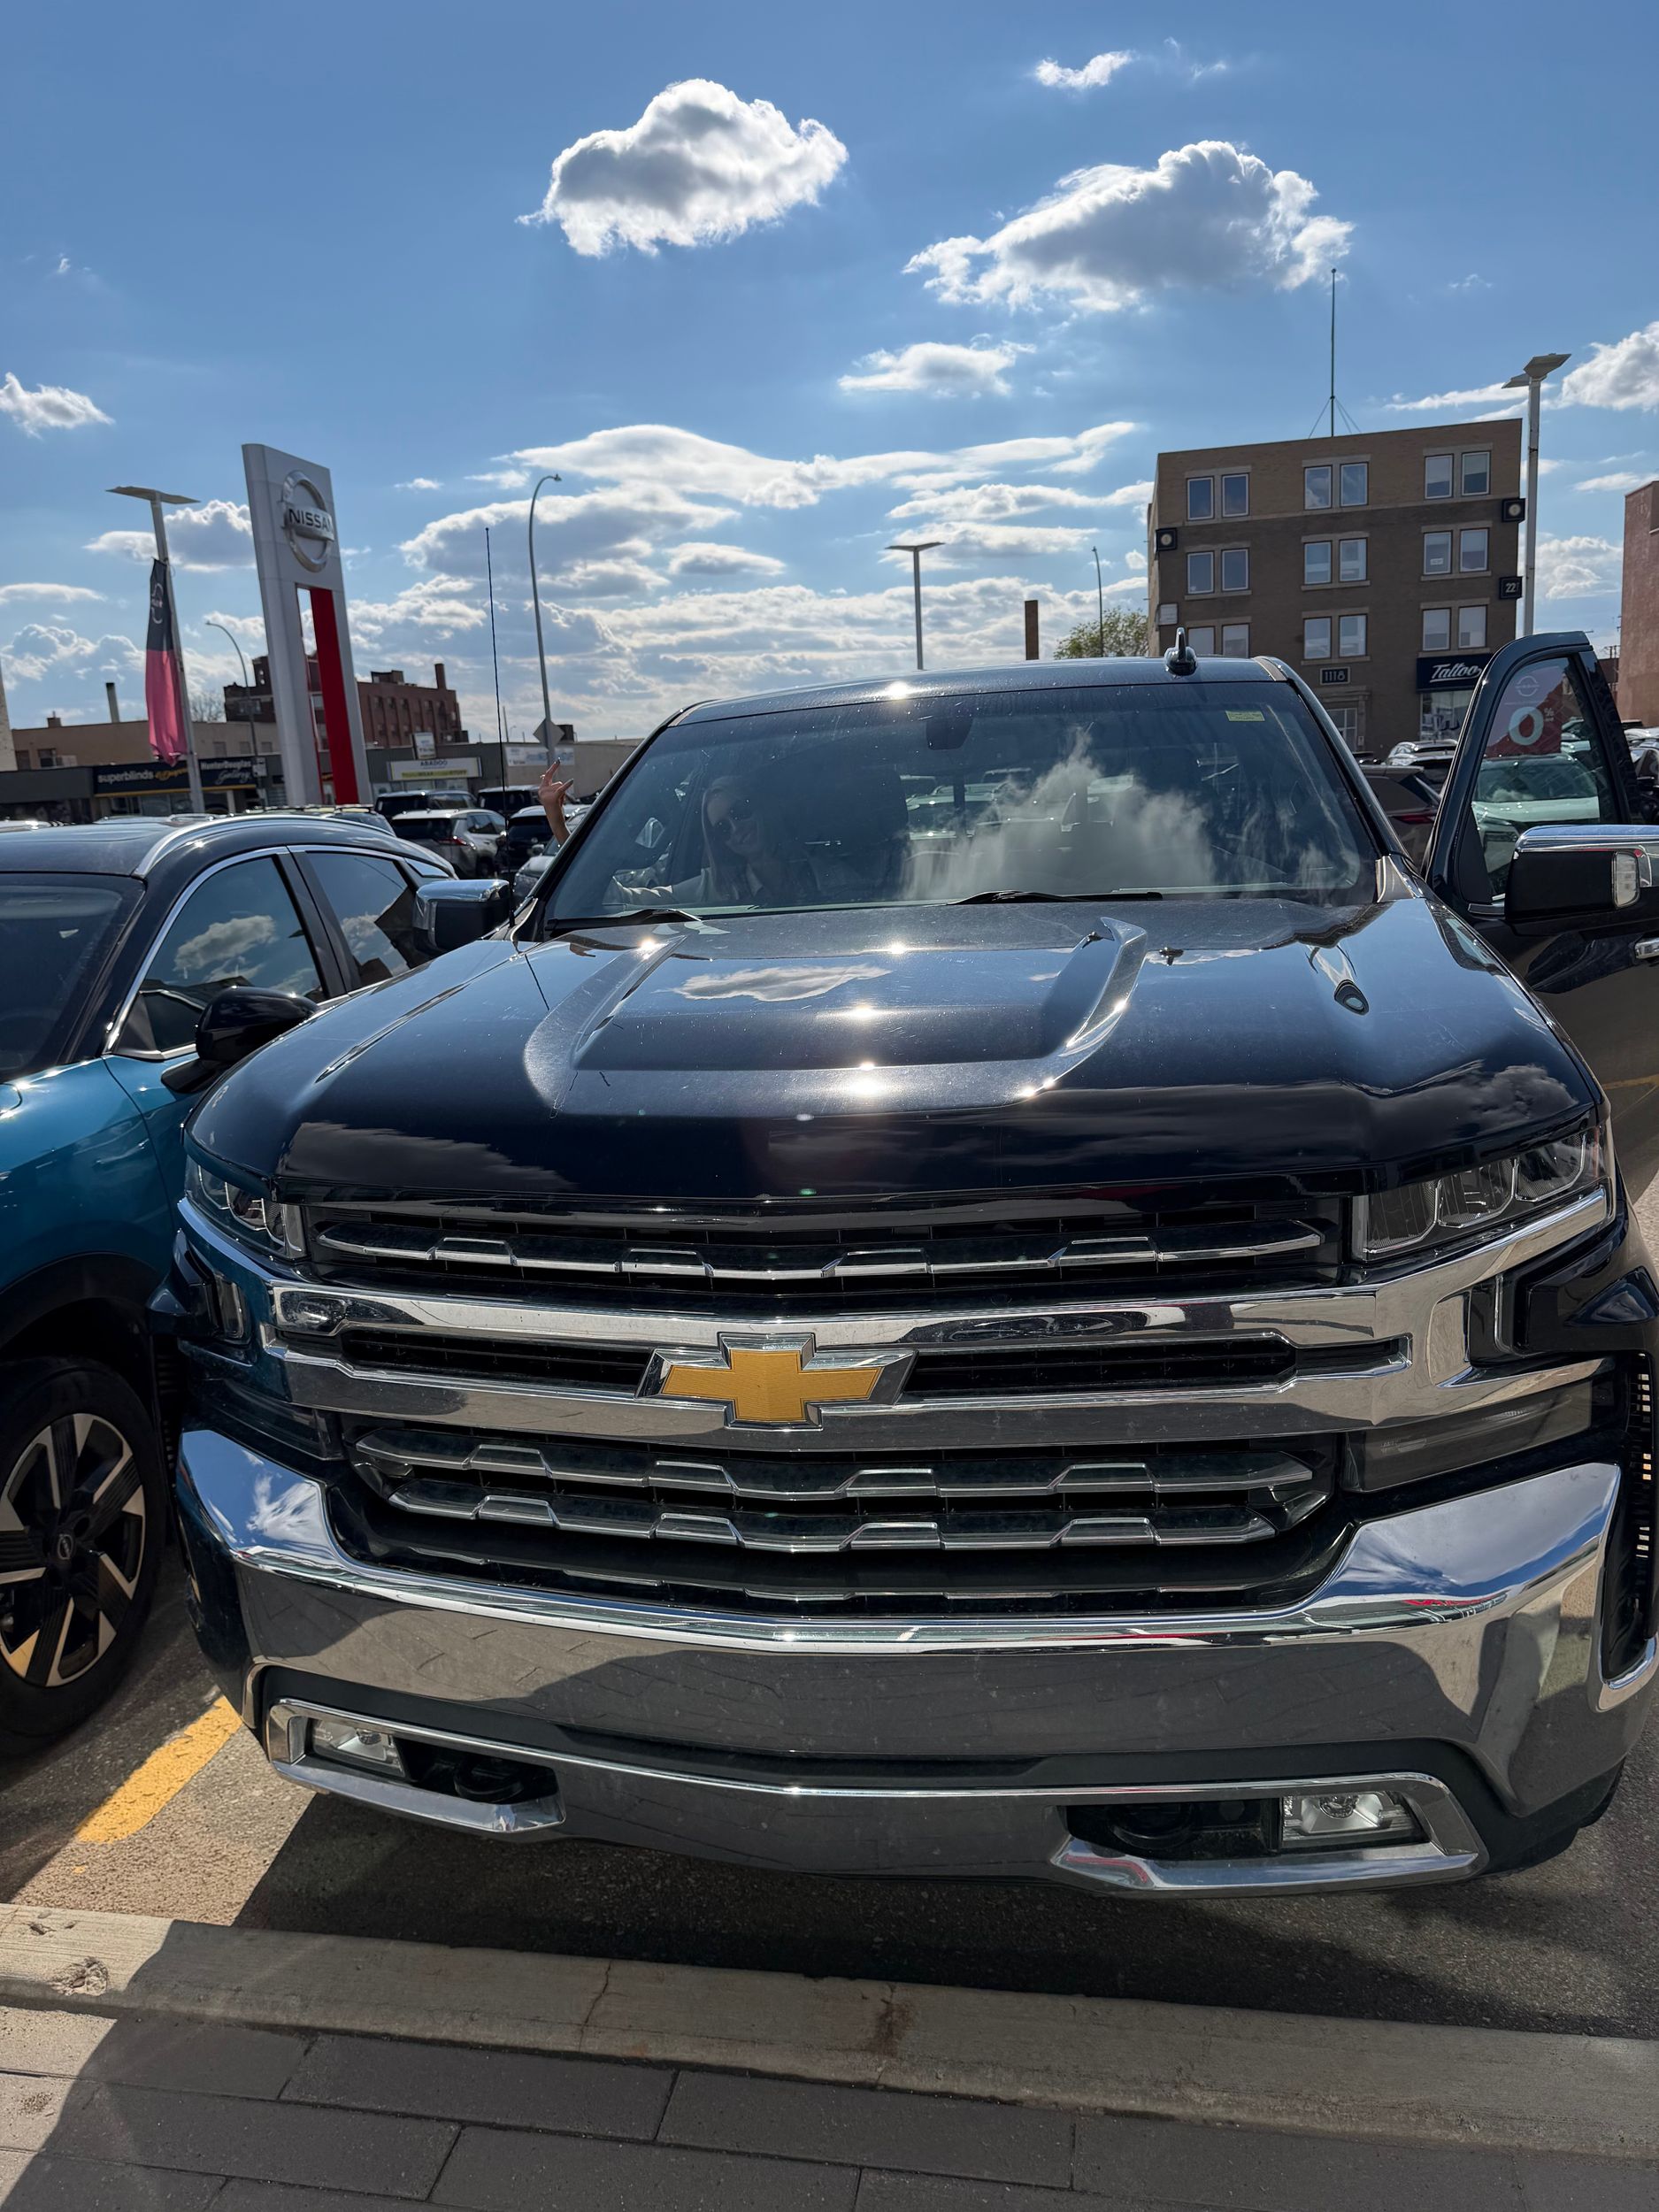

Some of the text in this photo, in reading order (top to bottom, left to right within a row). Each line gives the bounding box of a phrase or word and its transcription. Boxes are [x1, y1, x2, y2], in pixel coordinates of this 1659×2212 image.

[1325, 671, 1346, 681] 1118
[1431, 663, 1482, 681] Tattoo
[98, 770, 153, 784] superblinds
